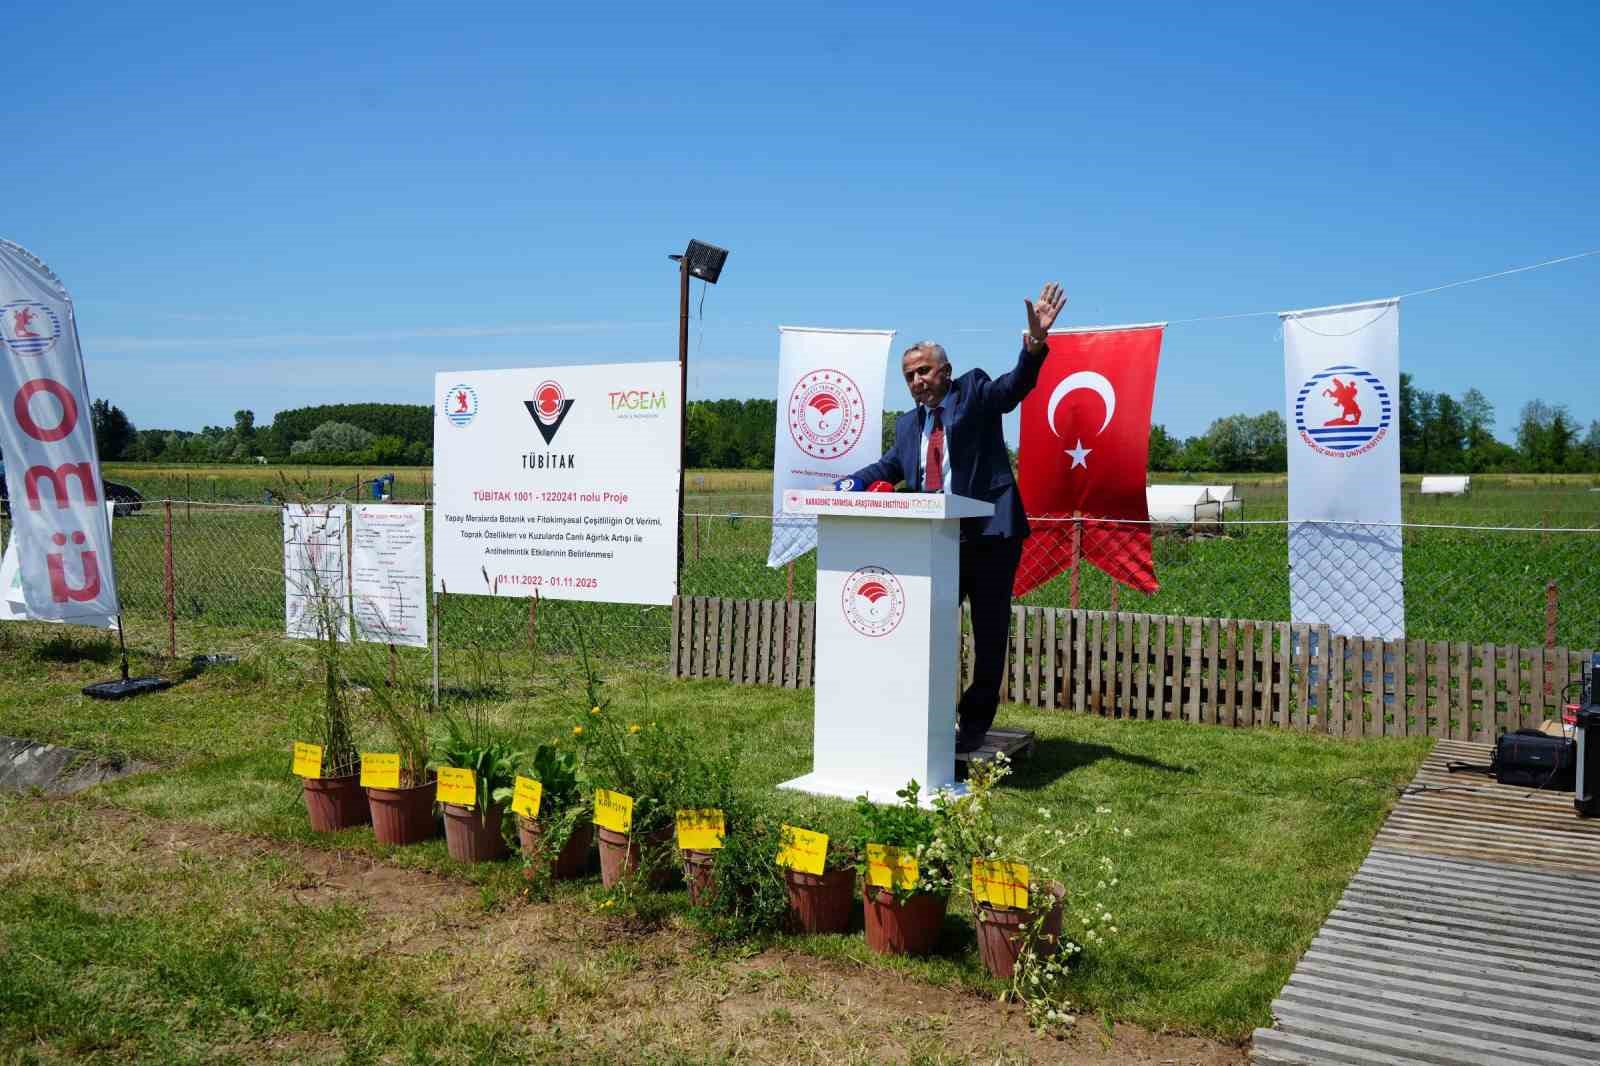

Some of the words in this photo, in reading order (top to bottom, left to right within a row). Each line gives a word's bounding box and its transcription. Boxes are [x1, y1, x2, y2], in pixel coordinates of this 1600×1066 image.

[607, 390, 666, 410] TAGEM
[522, 451, 575, 469] TÜBİTAK
[473, 489, 511, 502] TÜBİTAK
[513, 491, 532, 502] 1001
[580, 492, 600, 502] nolu
[603, 492, 628, 504] Proje
[498, 515, 525, 523] Botanik
[537, 515, 581, 525] Fitokimyasal
[624, 516, 634, 525] Ot
[461, 530, 482, 539] Toprak
[528, 531, 563, 540] Kuzularda
[567, 549, 613, 559] Belirlenmesi
[498, 575, 543, 585] 01.11.2022
[550, 576, 597, 588] 01.11.2025
